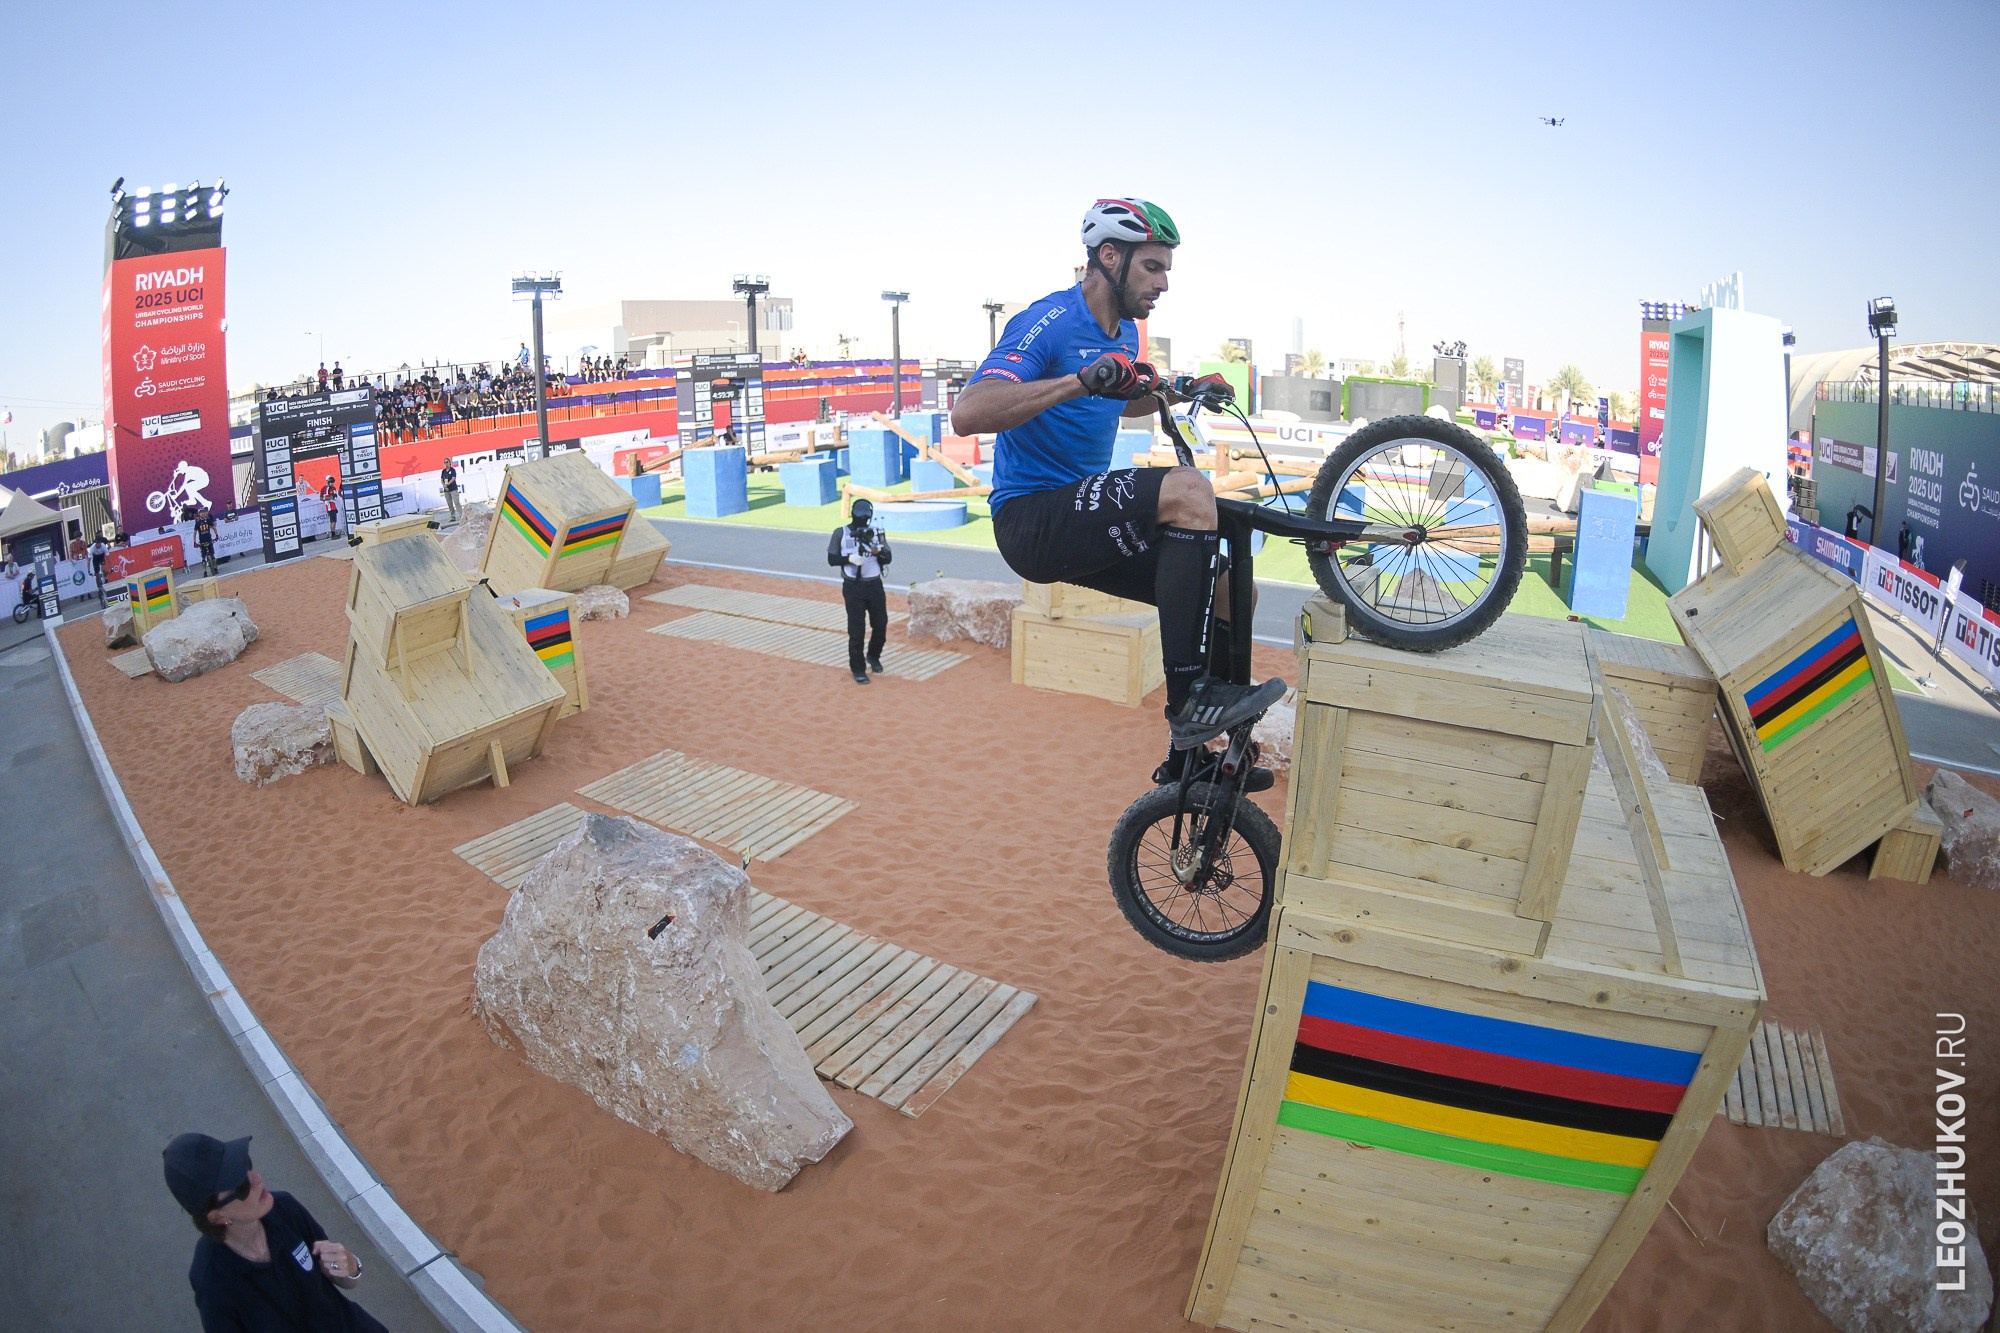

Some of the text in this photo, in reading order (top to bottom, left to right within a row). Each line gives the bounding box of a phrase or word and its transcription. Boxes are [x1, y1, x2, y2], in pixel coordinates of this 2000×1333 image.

[135, 266, 204, 292] RIYADH
[135, 288, 204, 309] 2025 UCI
[135, 304, 204, 318] URBAN CYCLING WORLD
[135, 312, 204, 328] CHAMPIONSHIPS
[160, 342, 206, 356] وزارة الرياضة
[160, 352, 206, 365] Ministry of Sport
[158, 380, 178, 388] SAUDI
[178, 376, 206, 385] CYCLING
[269, 404, 287, 414] UCI
[145, 417, 160, 426] UCI
[306, 417, 333, 428] FINISH
[1279, 427, 1313, 442] UCI
[270, 438, 286, 448] UCI
[1822, 444, 1832, 460] UCI
[1910, 447, 1944, 478] RIYADH
[1908, 476, 1943, 504] 2025 UCI
[364, 508, 380, 518] UCI
[1906, 508, 1940, 529] CHAMPIONSHIPS
[238, 530, 253, 538] وزارة
[278, 528, 295, 538] UCI
[35, 552, 52, 562] START
[151, 544, 173, 556] RIYADH
[42, 560, 48, 576] 1
[1894, 577, 1938, 620] TISSOT
